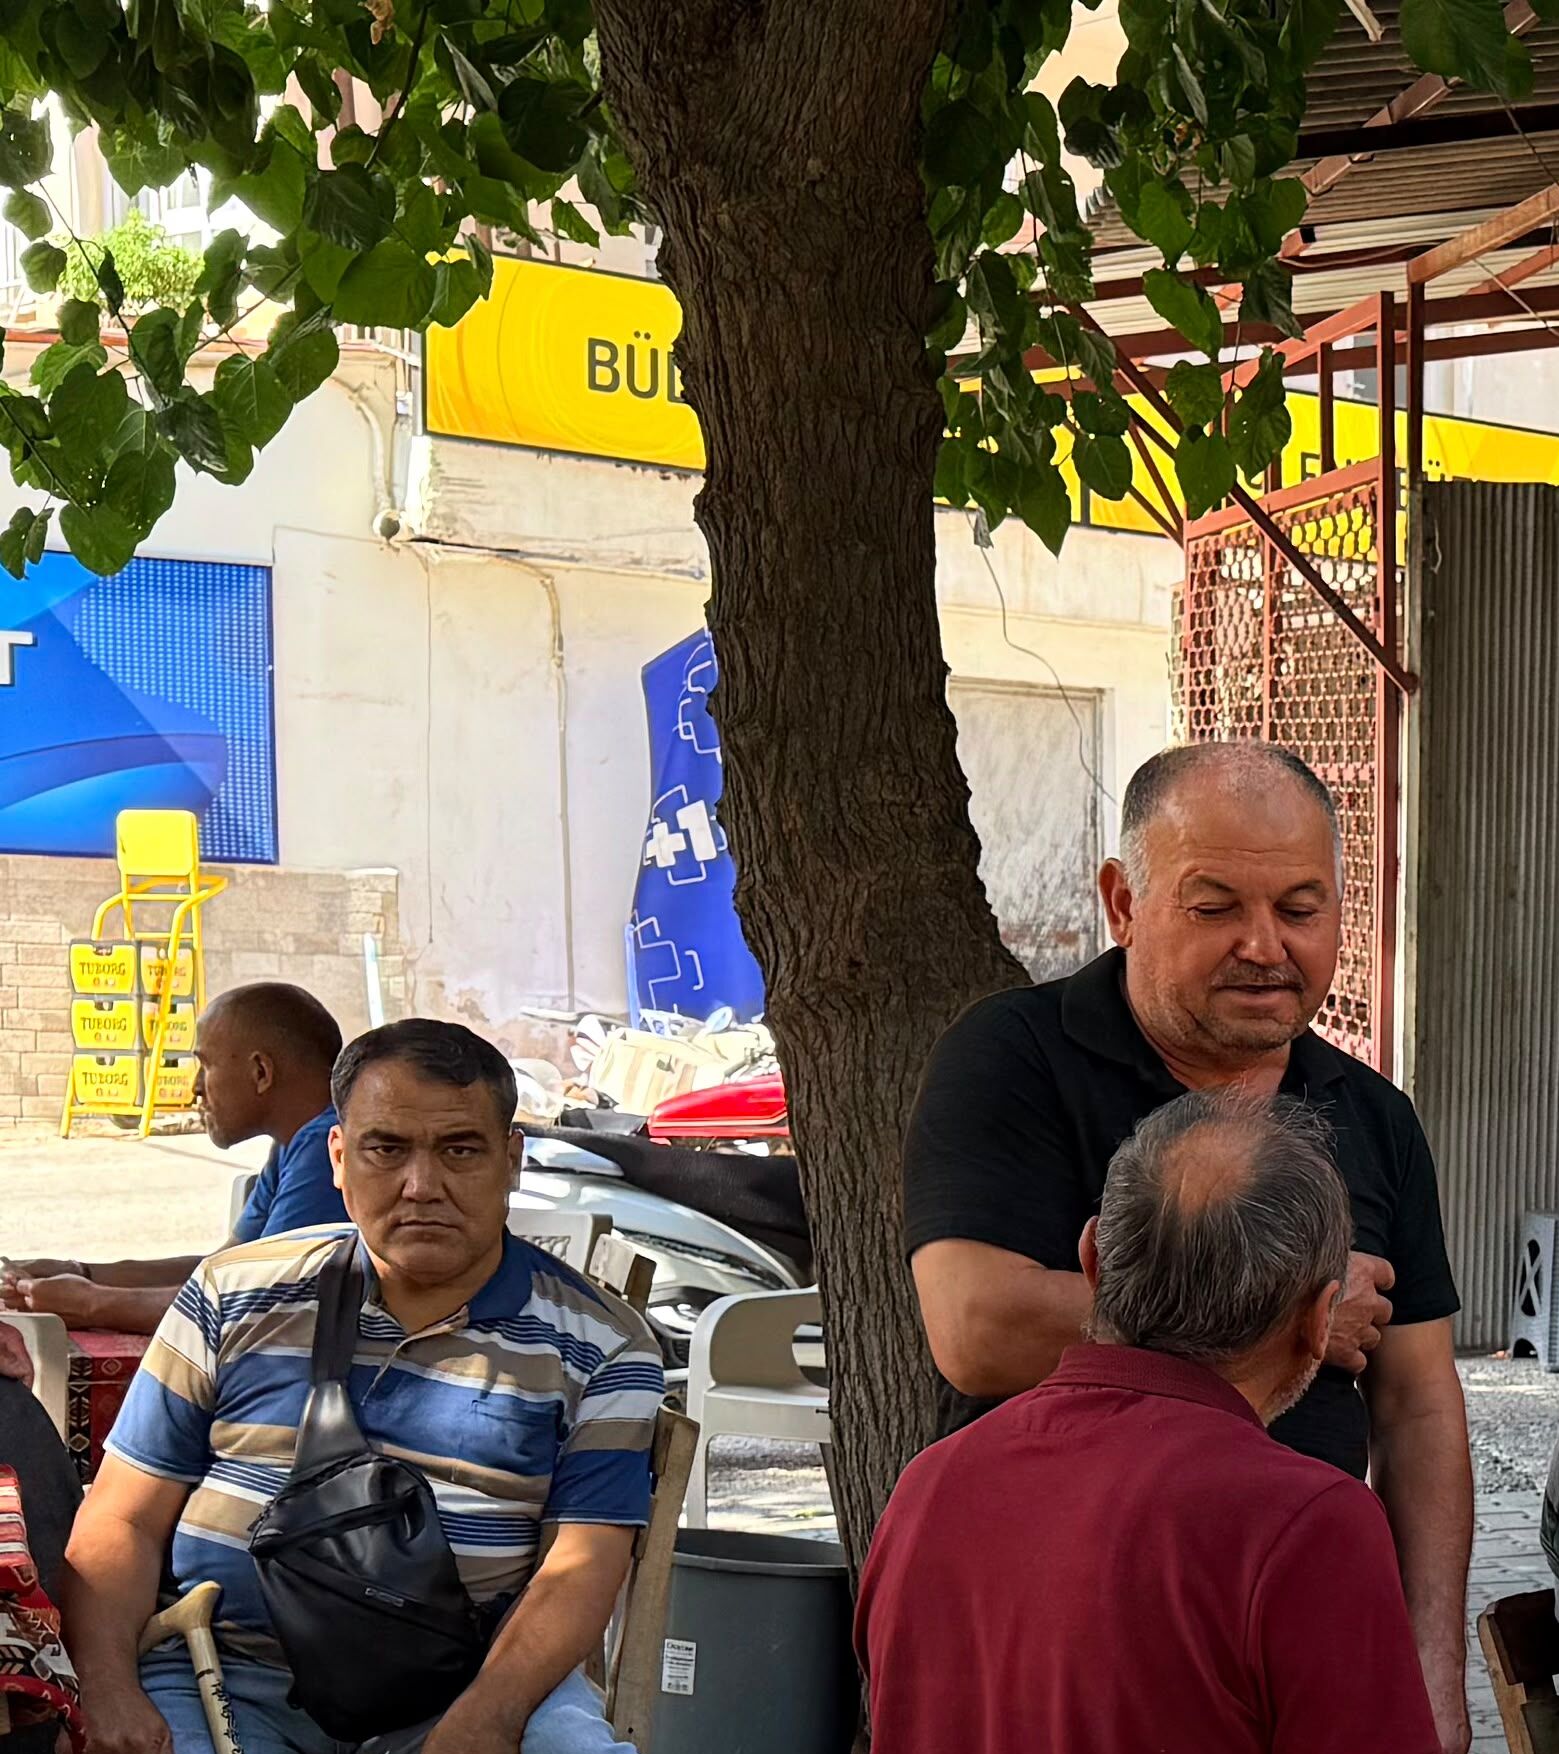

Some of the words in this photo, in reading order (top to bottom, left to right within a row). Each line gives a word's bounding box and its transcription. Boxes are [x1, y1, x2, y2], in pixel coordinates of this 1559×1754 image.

[79, 962, 126, 975] TUBORG
[80, 1017, 127, 1031] TUBORG
[82, 1072, 129, 1086] TUBORG
